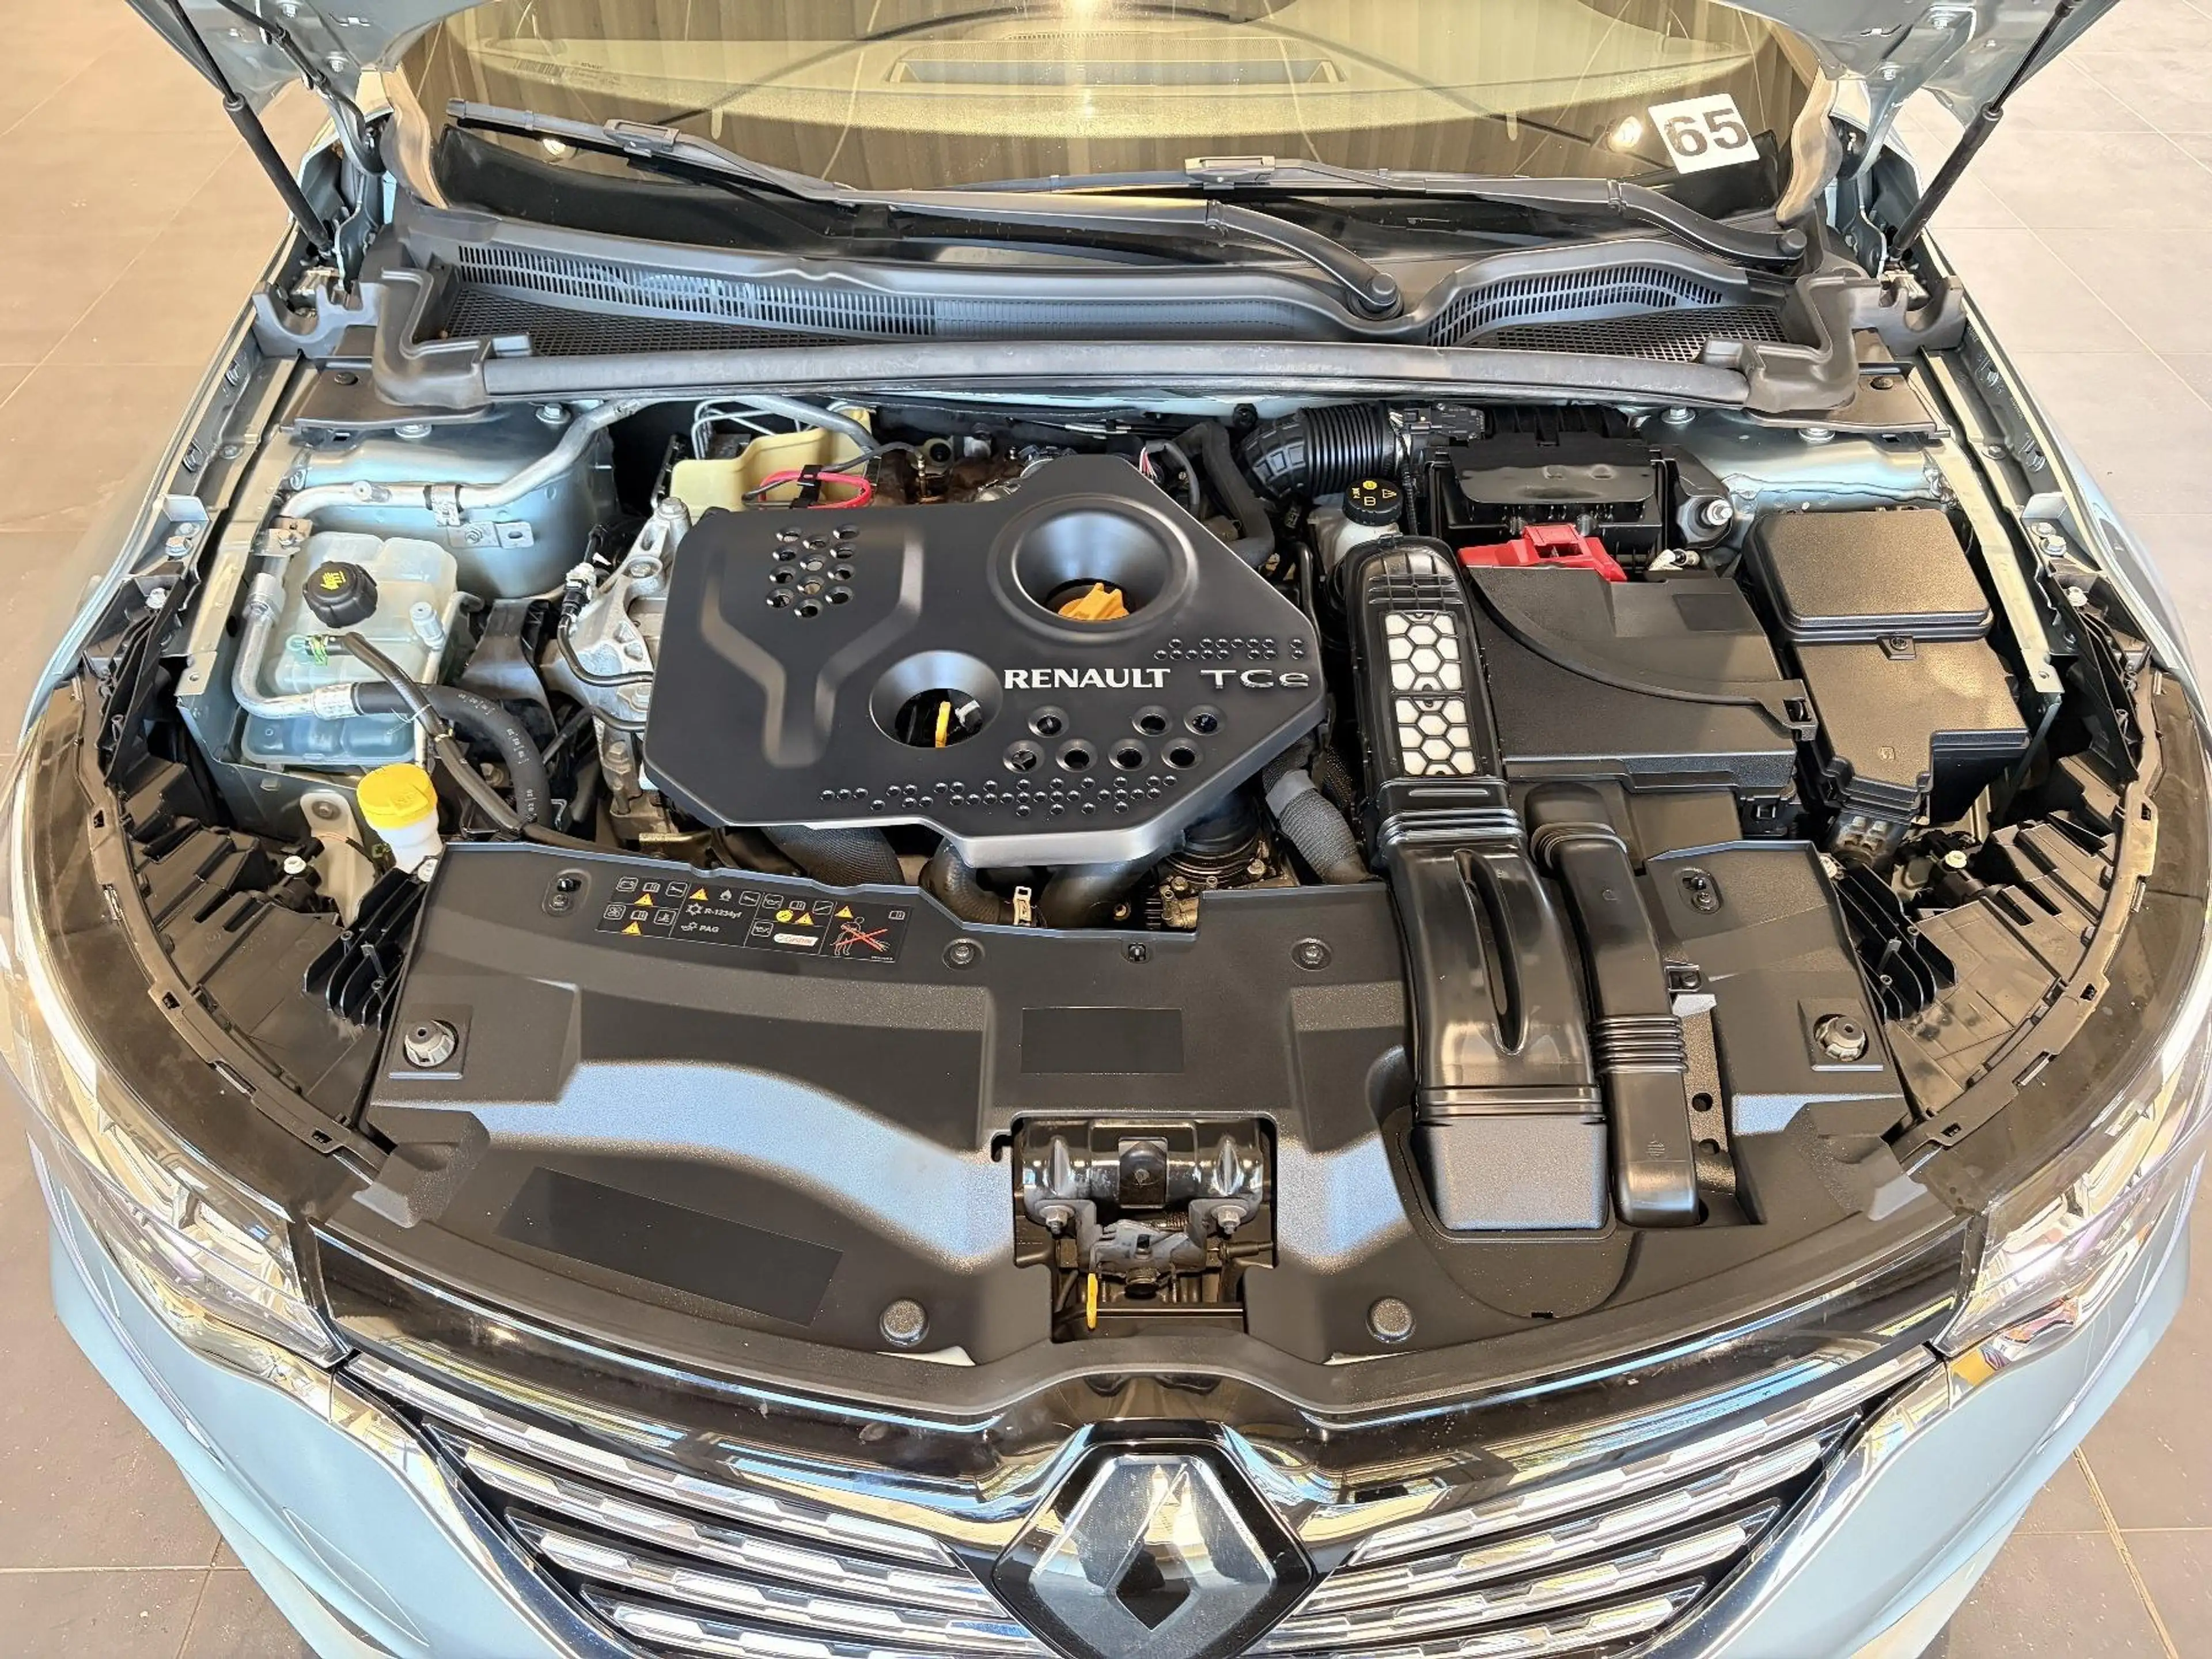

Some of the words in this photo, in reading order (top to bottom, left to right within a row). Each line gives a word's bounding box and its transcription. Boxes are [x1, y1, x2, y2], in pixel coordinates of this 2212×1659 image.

[1664, 108, 1748, 157] 65
[1004, 668, 1171, 689] RENAULT
[1200, 669, 1310, 689] TCe
[699, 925, 719, 933] PAG
